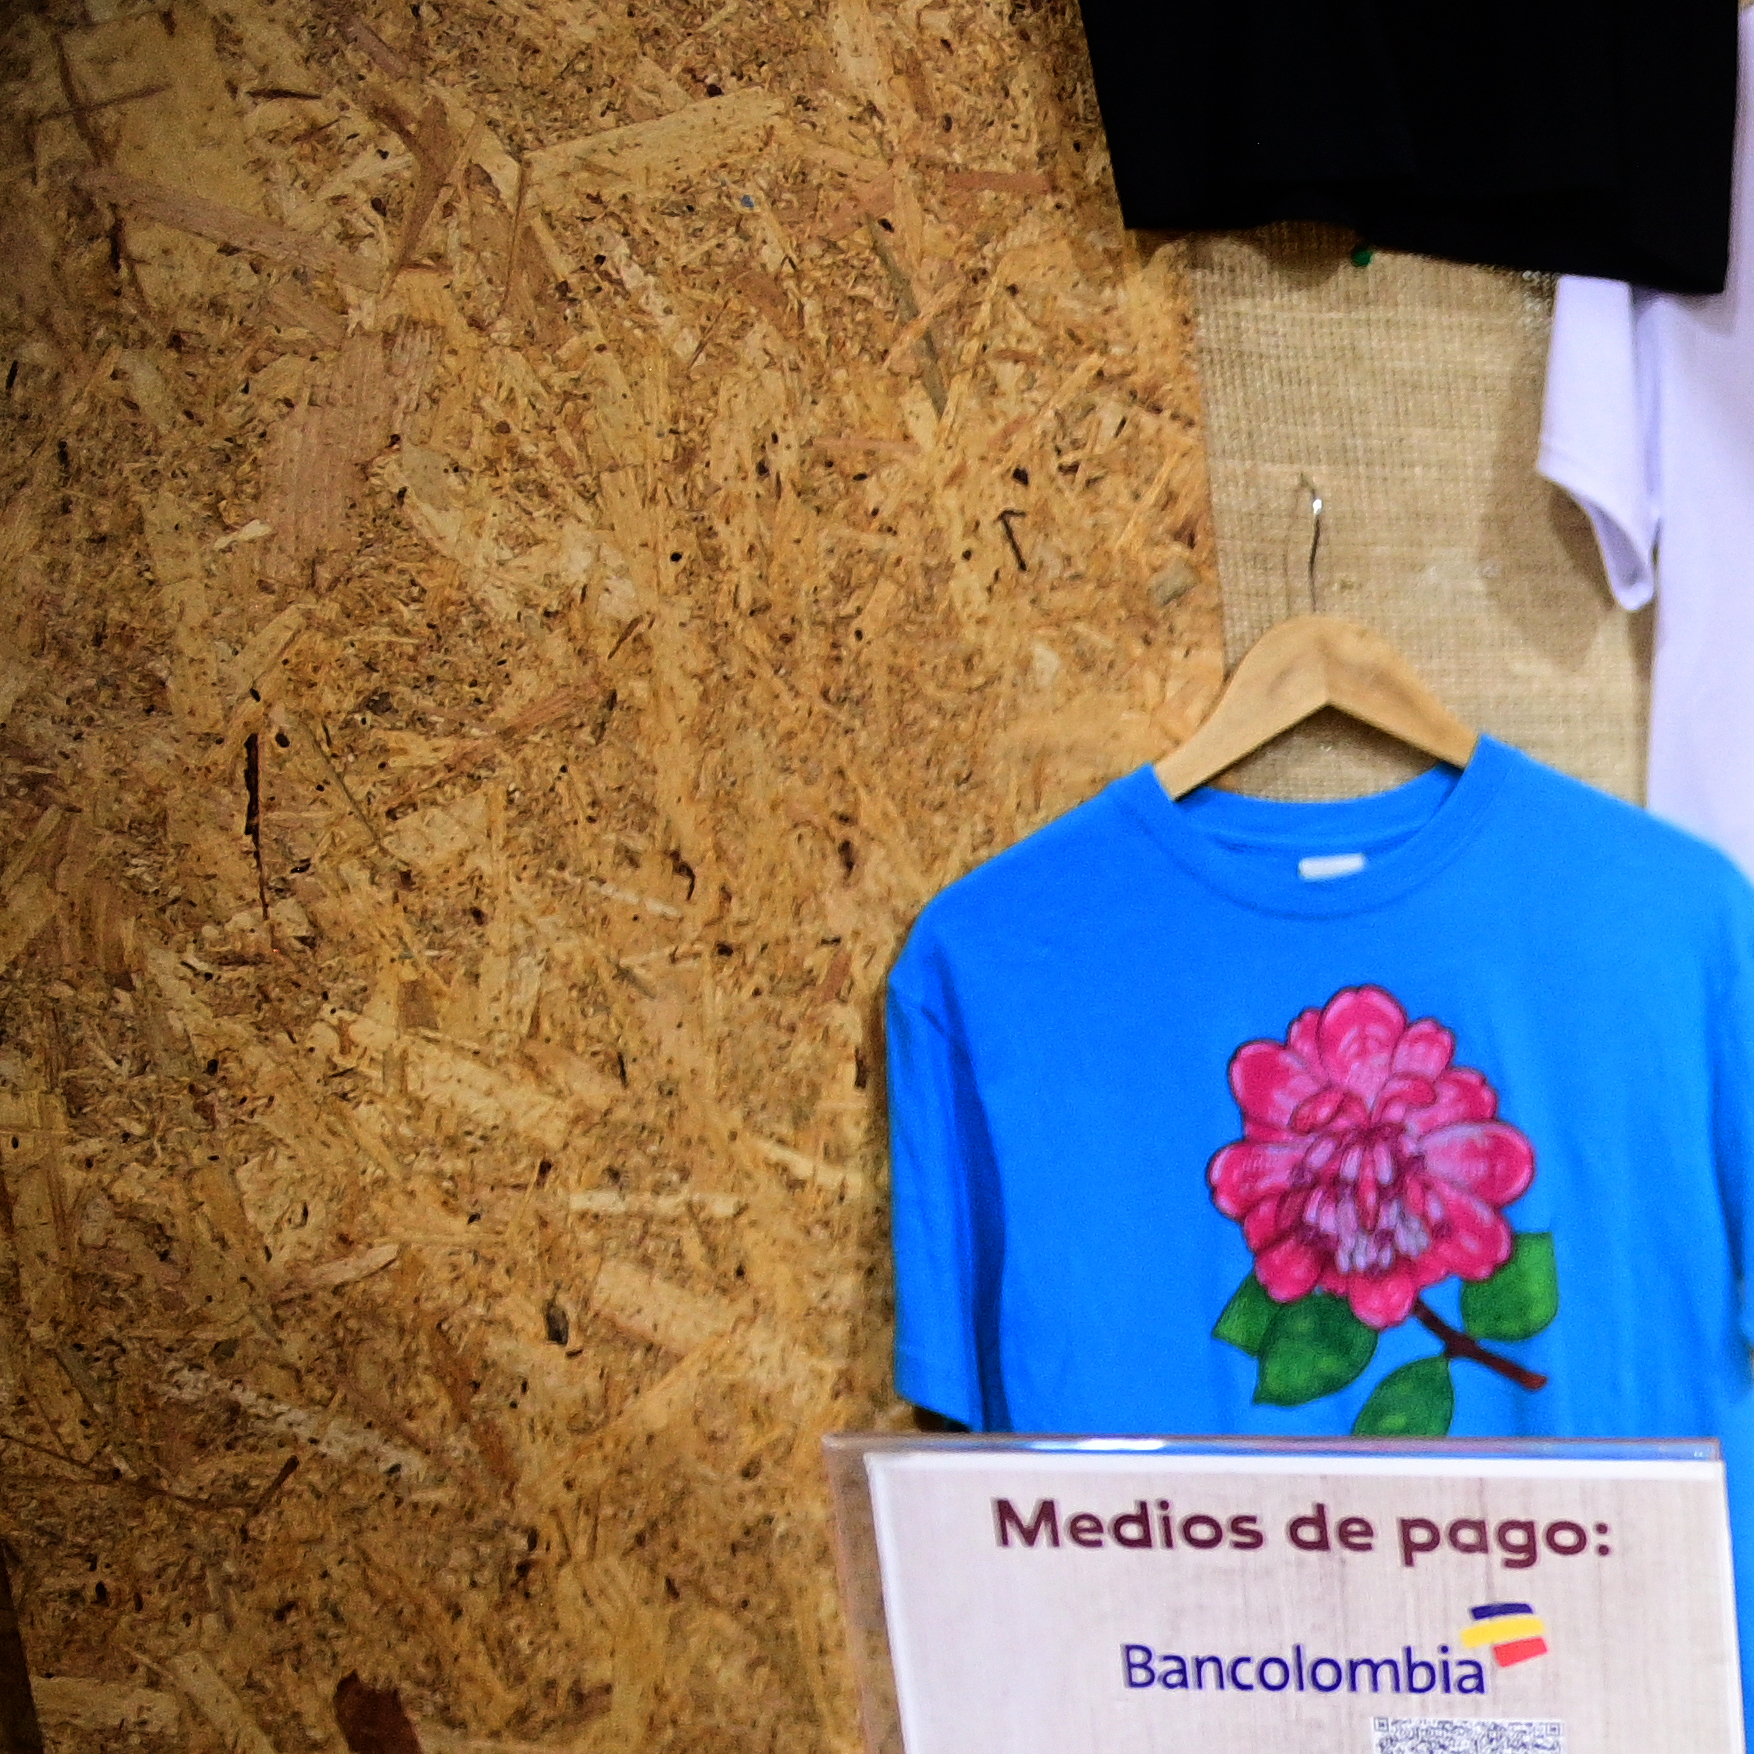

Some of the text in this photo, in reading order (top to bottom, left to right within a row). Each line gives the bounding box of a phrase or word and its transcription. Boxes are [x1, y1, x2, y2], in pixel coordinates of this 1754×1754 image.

[991, 1497, 1615, 1570] Medios de pago:
[1122, 1643, 1486, 1696] Bancolombia
